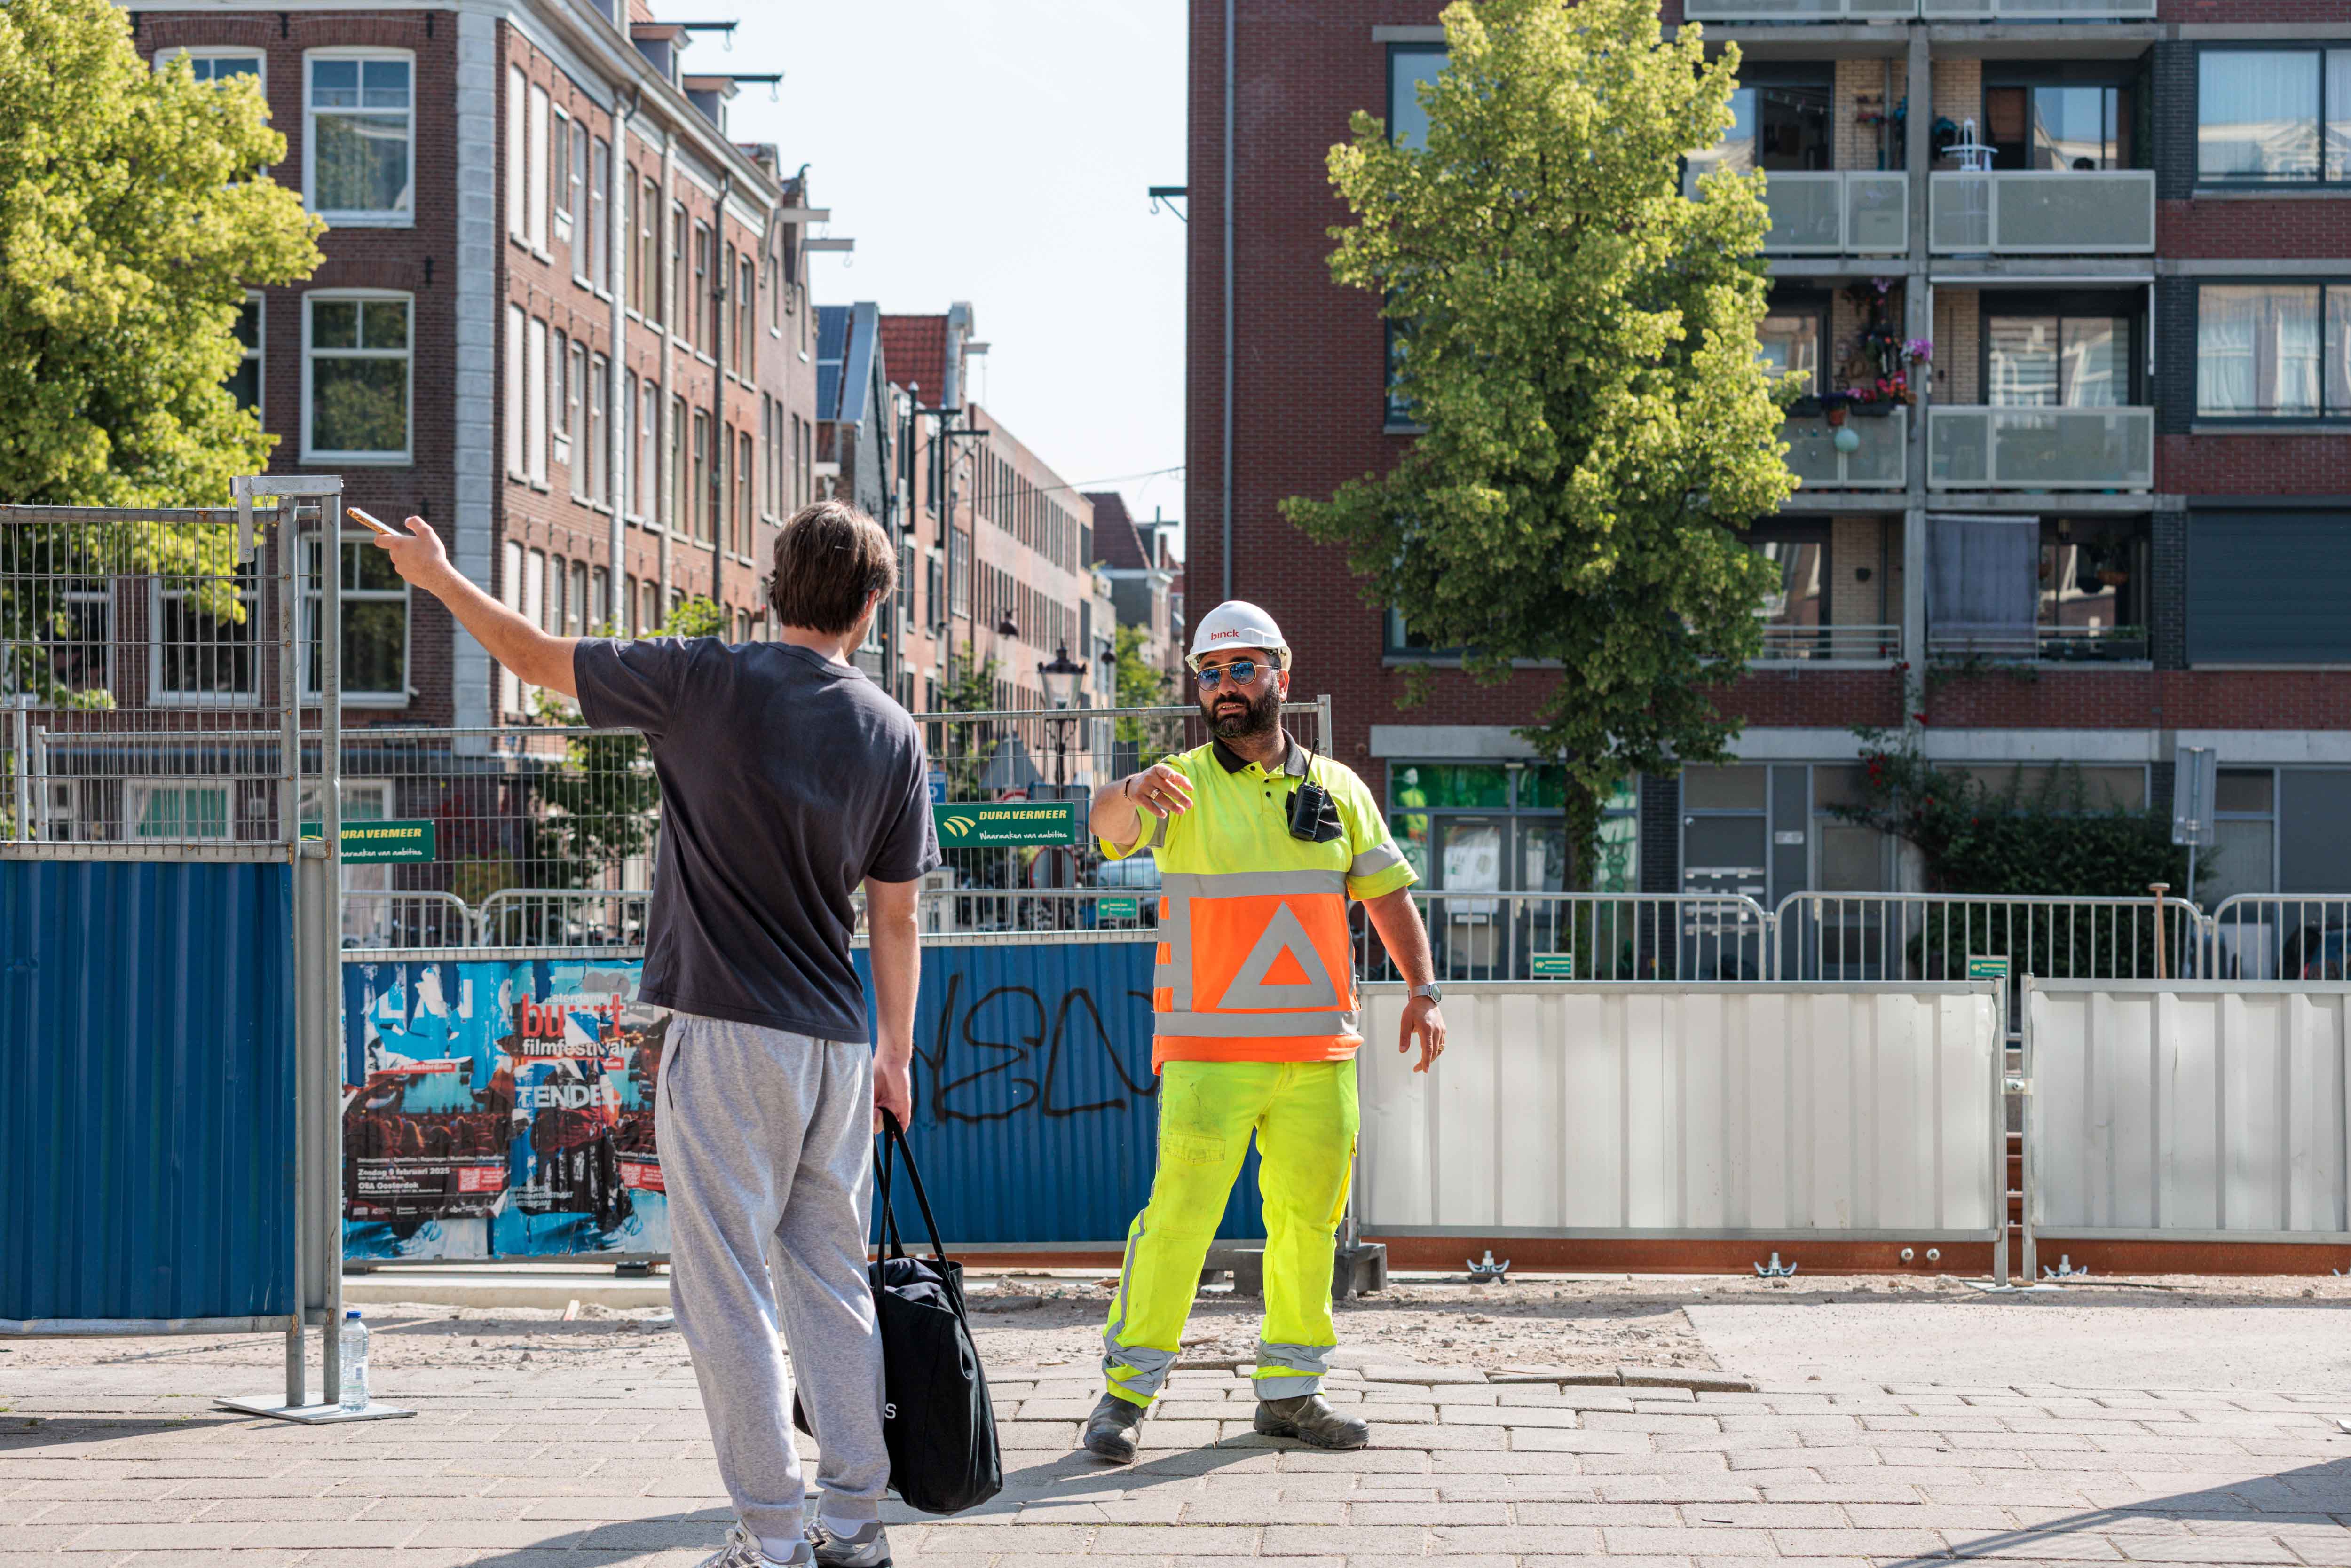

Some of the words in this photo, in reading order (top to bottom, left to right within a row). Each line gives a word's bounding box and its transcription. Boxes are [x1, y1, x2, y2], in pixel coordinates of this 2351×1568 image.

[1211, 629, 1239, 640] binck
[979, 811, 1011, 820] DURA
[1012, 810, 1067, 819] VERMEER
[340, 830, 365, 839] URA
[366, 828, 422, 838] VERMEER
[979, 830, 1022, 840] Waarmaken
[1038, 830, 1068, 839] ambities
[340, 848, 376, 857] aarmaken
[392, 847, 423, 856] ambities
[522, 993, 625, 1038] but
